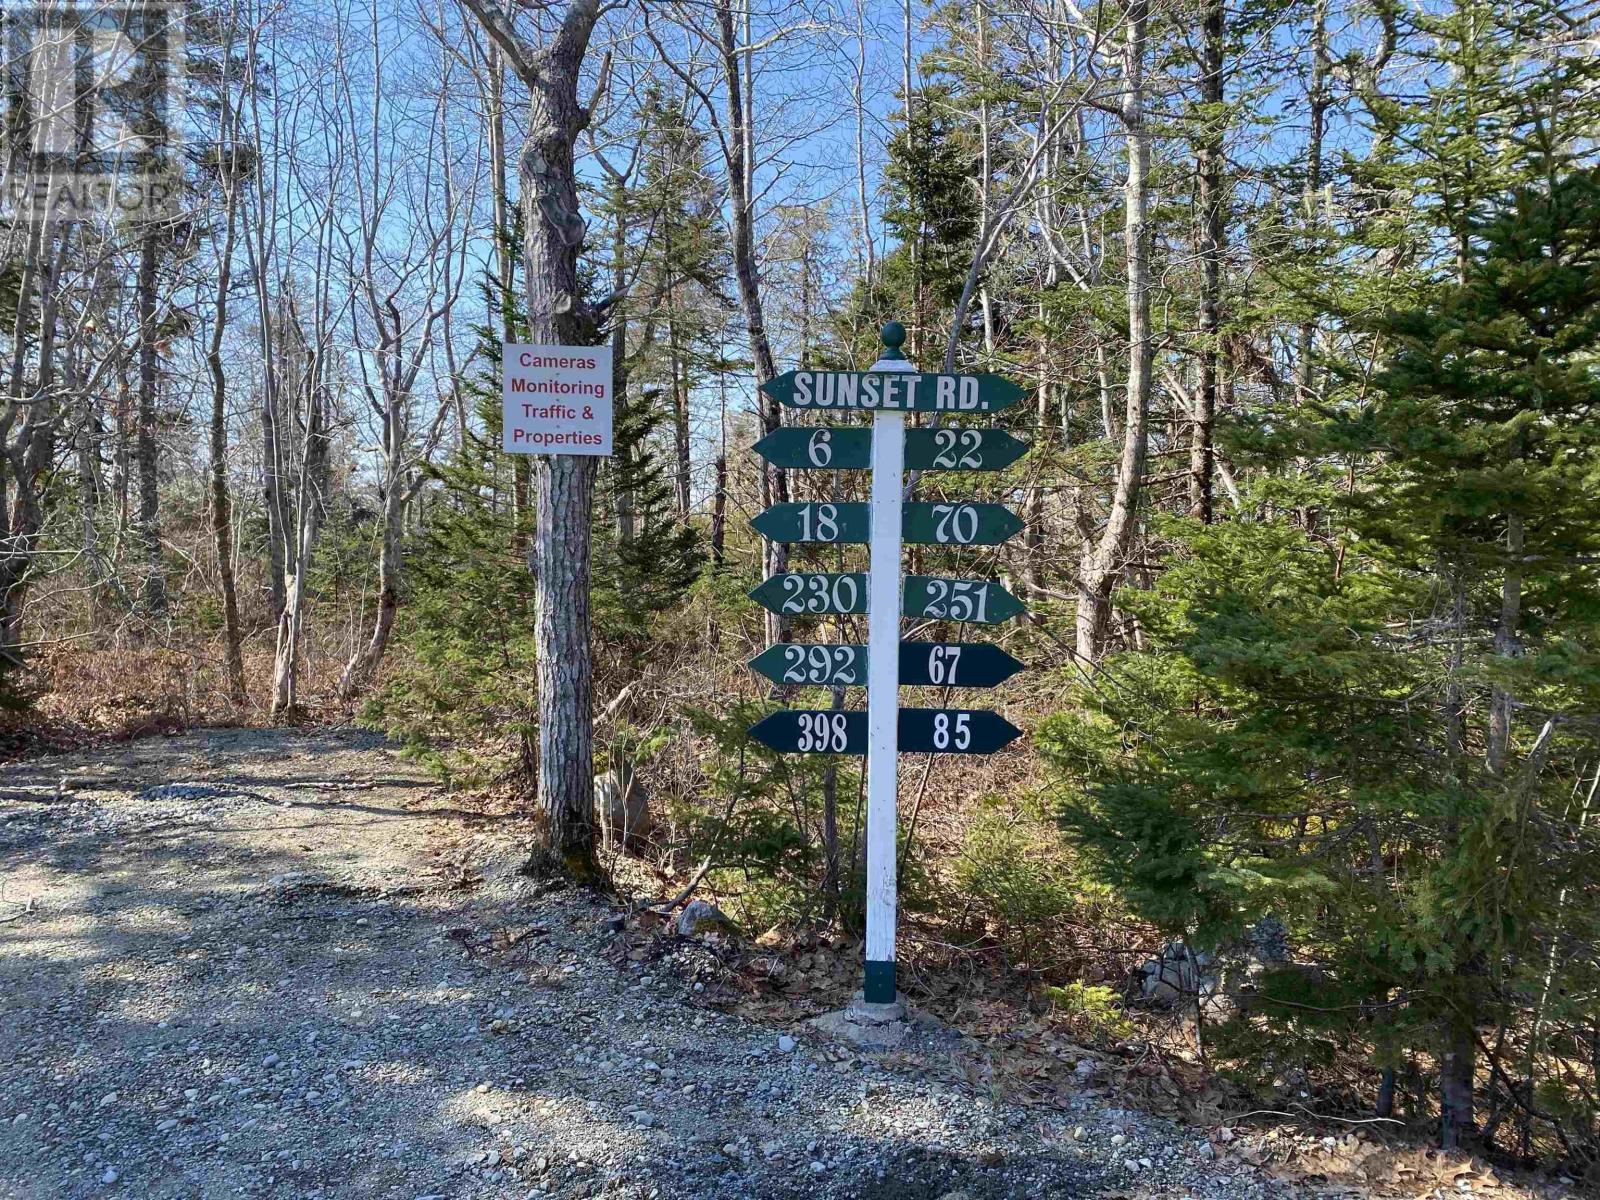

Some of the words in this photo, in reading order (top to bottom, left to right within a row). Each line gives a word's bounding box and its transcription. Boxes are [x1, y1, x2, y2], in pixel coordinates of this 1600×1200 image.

[519, 352, 596, 370] Cameras
[511, 378, 605, 399] Monitoring
[793, 372, 922, 408] SUNSET
[936, 375, 989, 410] RD.
[521, 403, 577, 420] Traffic
[582, 405, 595, 420] &
[513, 428, 603, 447] Properties
[808, 428, 832, 468] 6
[932, 429, 983, 469] 22
[797, 503, 840, 542] 18
[931, 504, 979, 544] 70
[782, 574, 858, 614] 230
[922, 579, 989, 623] 251
[783, 645, 856, 684] 292
[928, 645, 961, 685] 67
[797, 713, 848, 752] 398
[933, 712, 971, 750] 85
